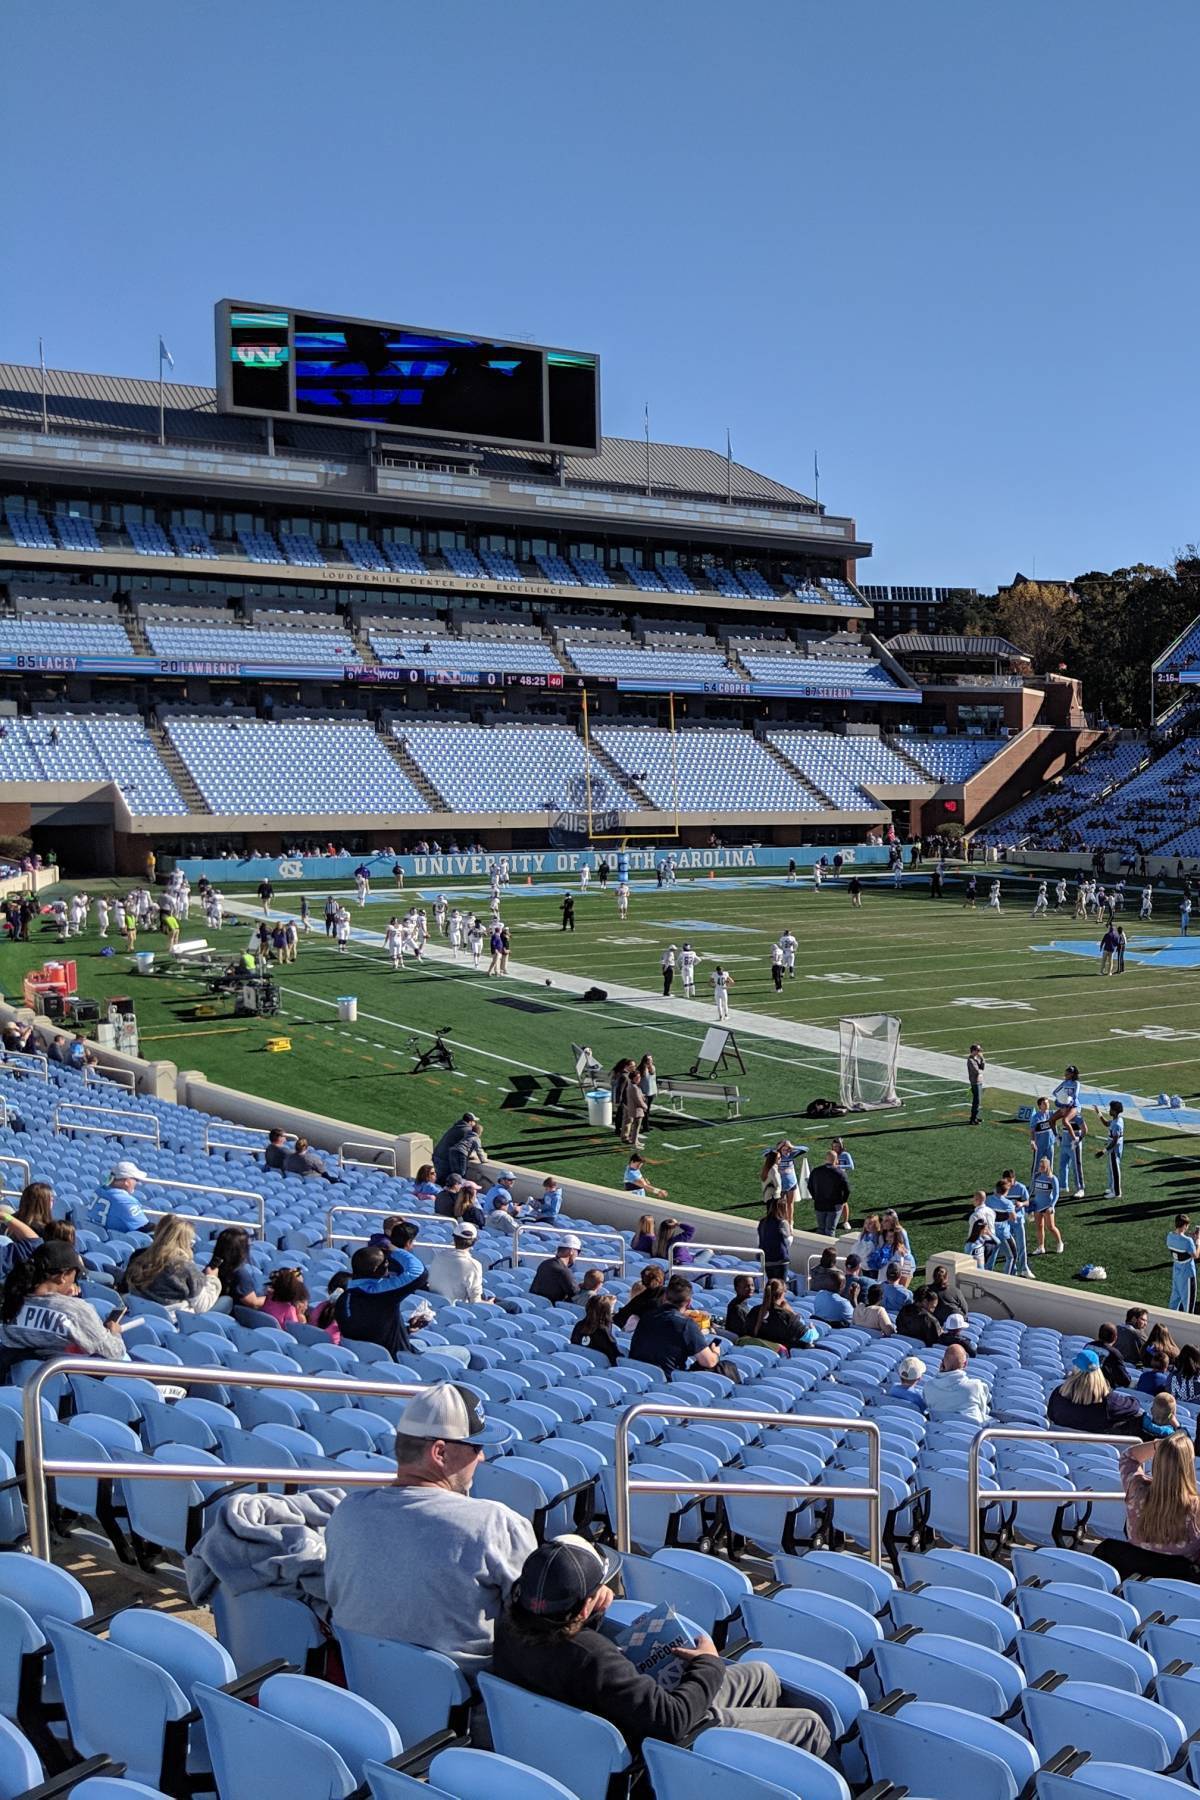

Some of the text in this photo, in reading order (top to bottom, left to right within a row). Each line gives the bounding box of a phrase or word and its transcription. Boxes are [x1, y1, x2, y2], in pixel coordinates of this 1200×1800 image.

[322, 571, 565, 595] LOUDERMILK CENTER FOR EXCELLENCE
[17, 656, 78, 670] 85 LACEY
[160, 660, 241, 675] 20 LAWRENCE
[379, 669, 418, 682] WCU 0
[460, 674, 479, 683] UNC
[488, 673, 496, 686] 0
[519, 676, 546, 686] 48:25
[551, 677, 561, 687] 40
[578, 679, 584, 687] &
[704, 682, 750, 694] 64 COOPER
[818, 687, 851, 699] SEVERIN
[557, 853, 580, 872] OF
[595, 851, 656, 872] NOTH
[1018, 1106, 1032, 1120] 20
[24, 1307, 66, 1334] PINK
[639, 1635, 684, 1673] POPCORN
